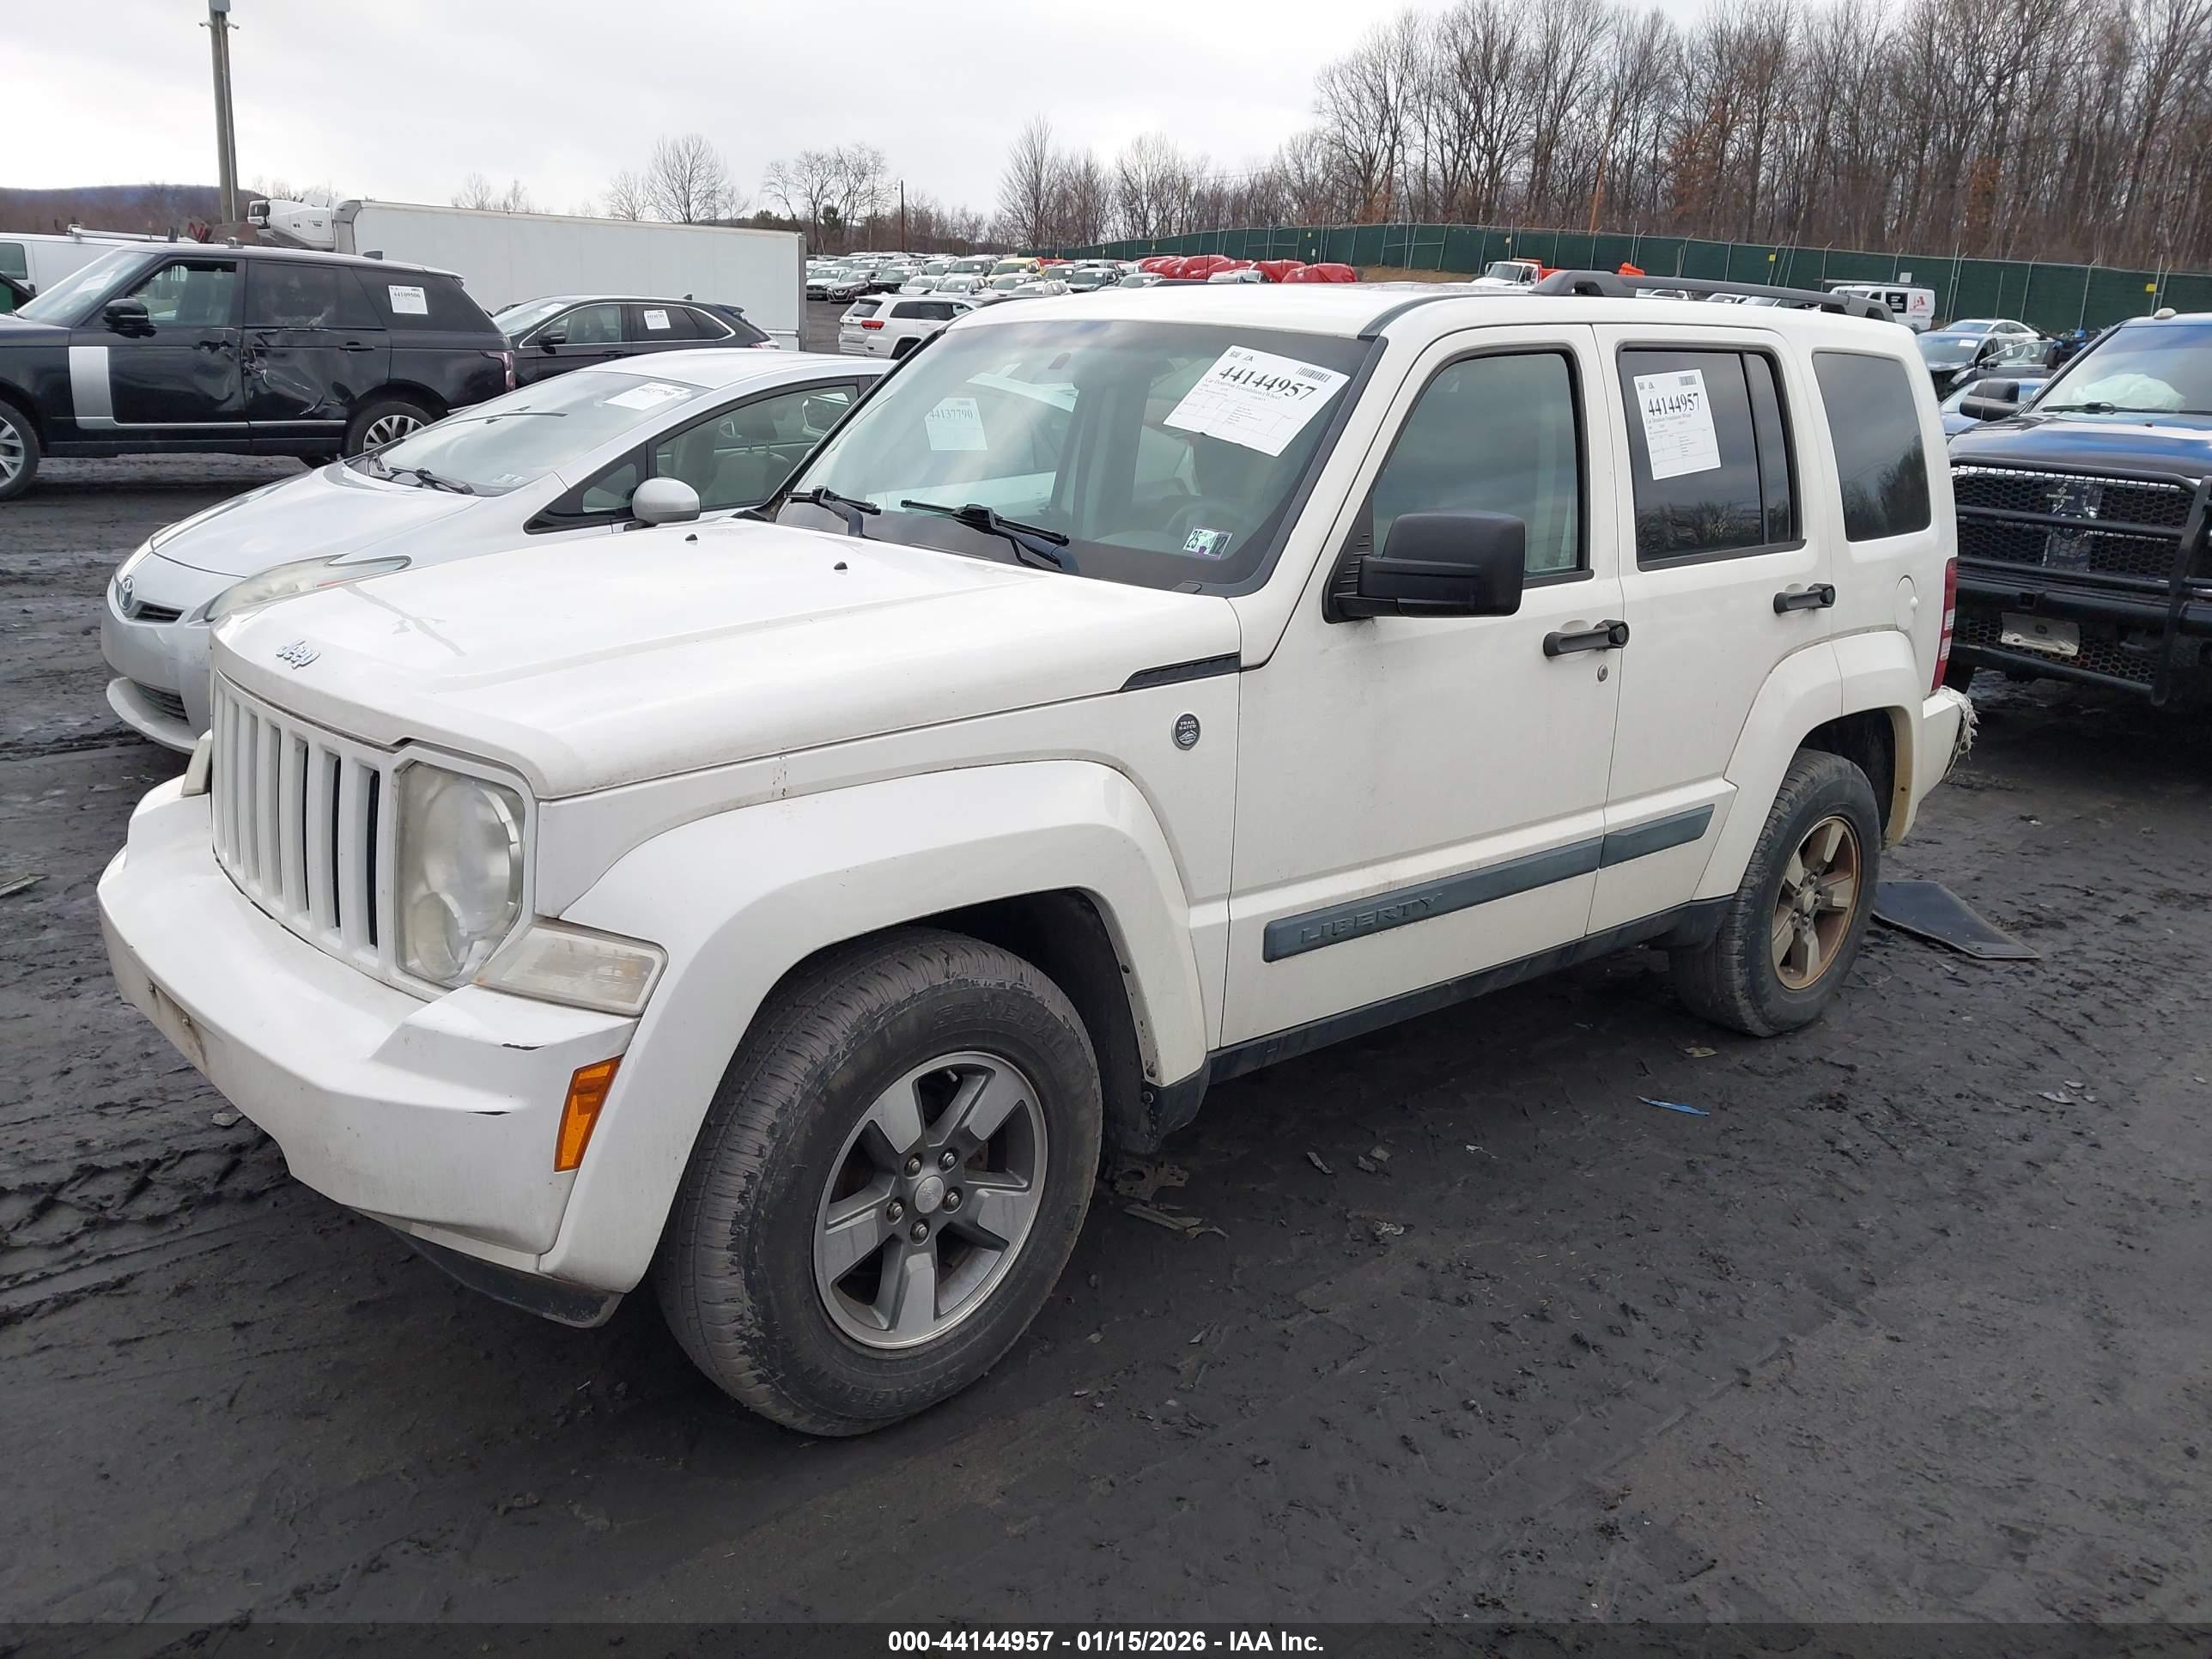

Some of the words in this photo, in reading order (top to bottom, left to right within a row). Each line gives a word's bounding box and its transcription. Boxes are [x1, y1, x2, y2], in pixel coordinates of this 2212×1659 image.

[1218, 365, 1317, 401] 44144957
[1648, 392, 1700, 416] 44144957
[1186, 531, 1202, 549] 25
[276, 639, 321, 670] Jeep
[1299, 892, 1443, 945] LIBERTY
